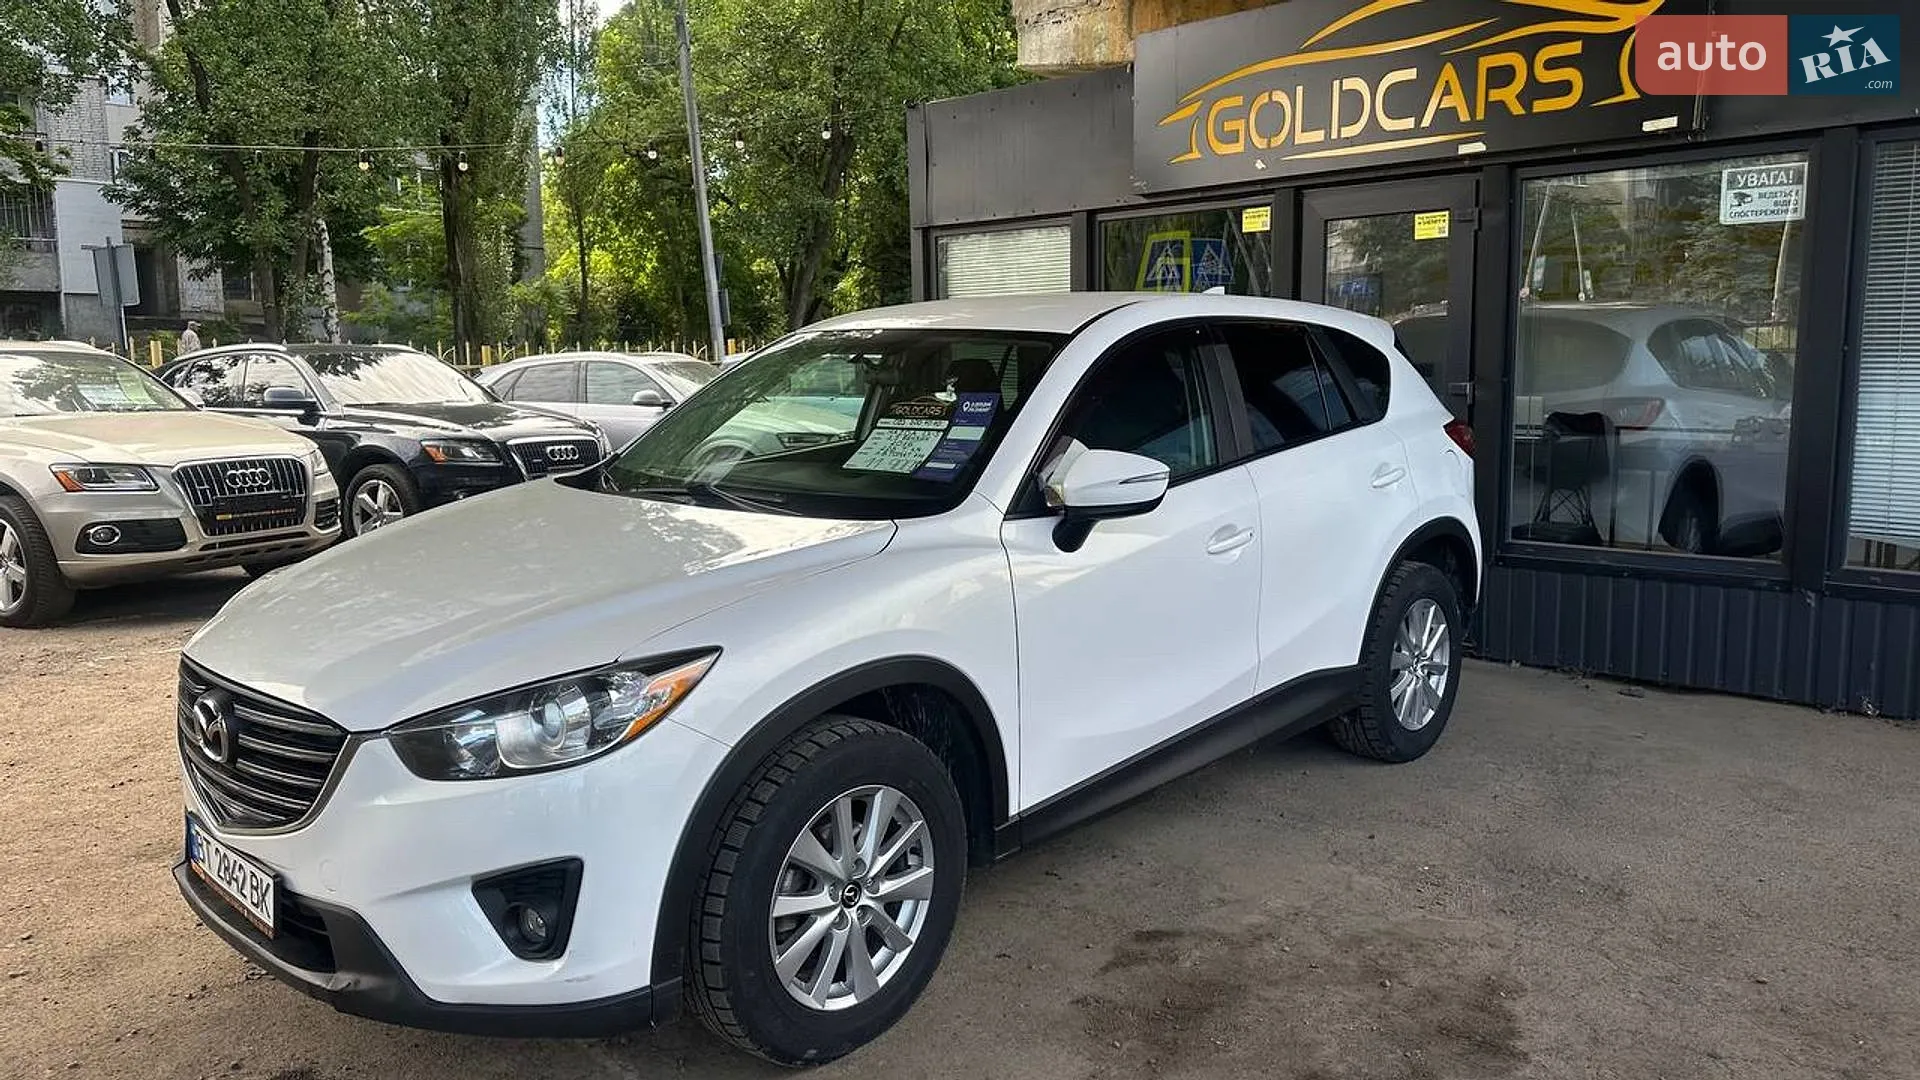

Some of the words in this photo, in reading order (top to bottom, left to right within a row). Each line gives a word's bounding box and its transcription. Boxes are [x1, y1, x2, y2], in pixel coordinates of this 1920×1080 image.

[1206, 40, 1584, 156] GOLDCARS
[1736, 170, 1794, 188] УВАГА!
[214, 846, 248, 900] 2842
[249, 869, 271, 919] BK
